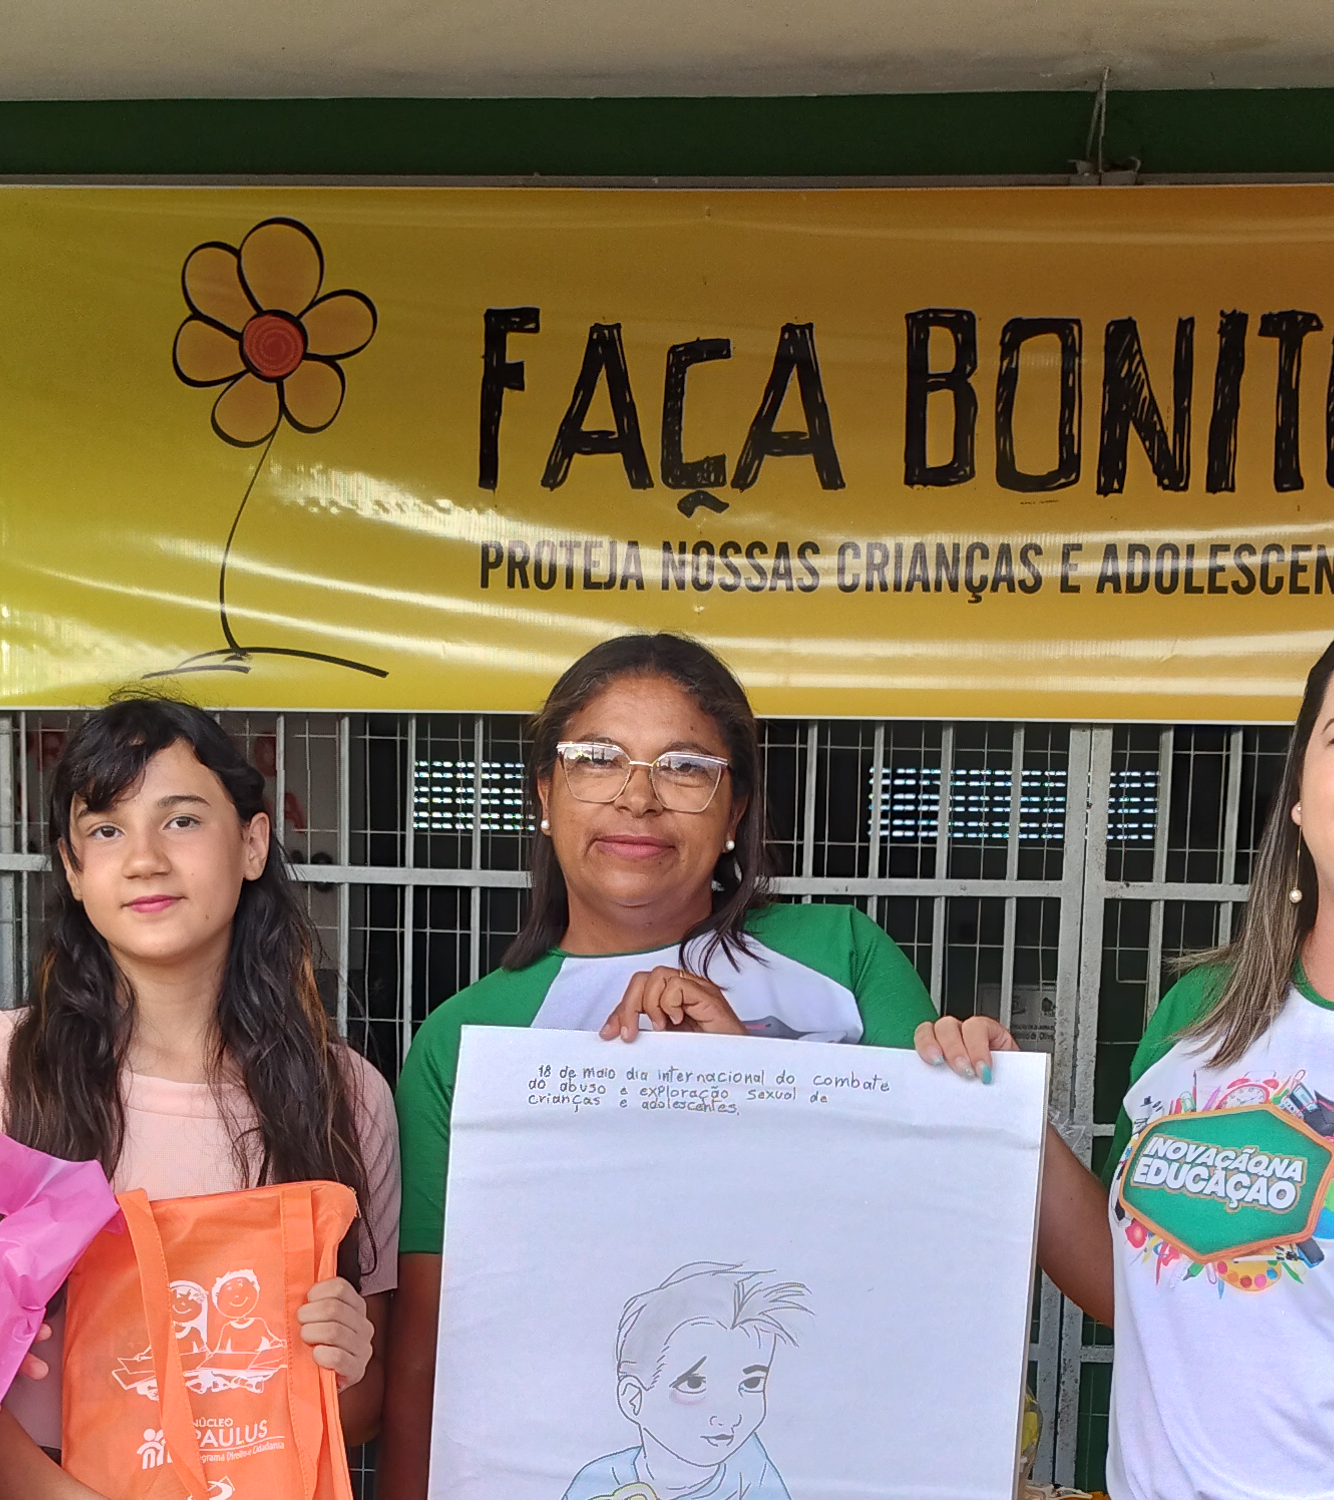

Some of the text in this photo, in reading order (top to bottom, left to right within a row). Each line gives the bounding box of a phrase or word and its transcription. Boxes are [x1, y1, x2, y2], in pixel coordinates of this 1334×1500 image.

[478, 306, 845, 518] FAÇA
[479, 539, 646, 593] PROTEJA
[660, 540, 821, 594] NOSSAS
[836, 541, 1043, 604] CRIANÇAS
[1060, 544, 1082, 594] E
[528, 1077, 547, 1090] do
[560, 1078, 607, 1095] abuso
[639, 1084, 730, 1100] exploração
[809, 1090, 829, 1104] de
[538, 1064, 891, 1093] 18 de maio dia internacional do combate
[528, 1092, 602, 1113] crianças
[619, 1098, 629, 1109] e
[200, 1451, 226, 1464] grama
